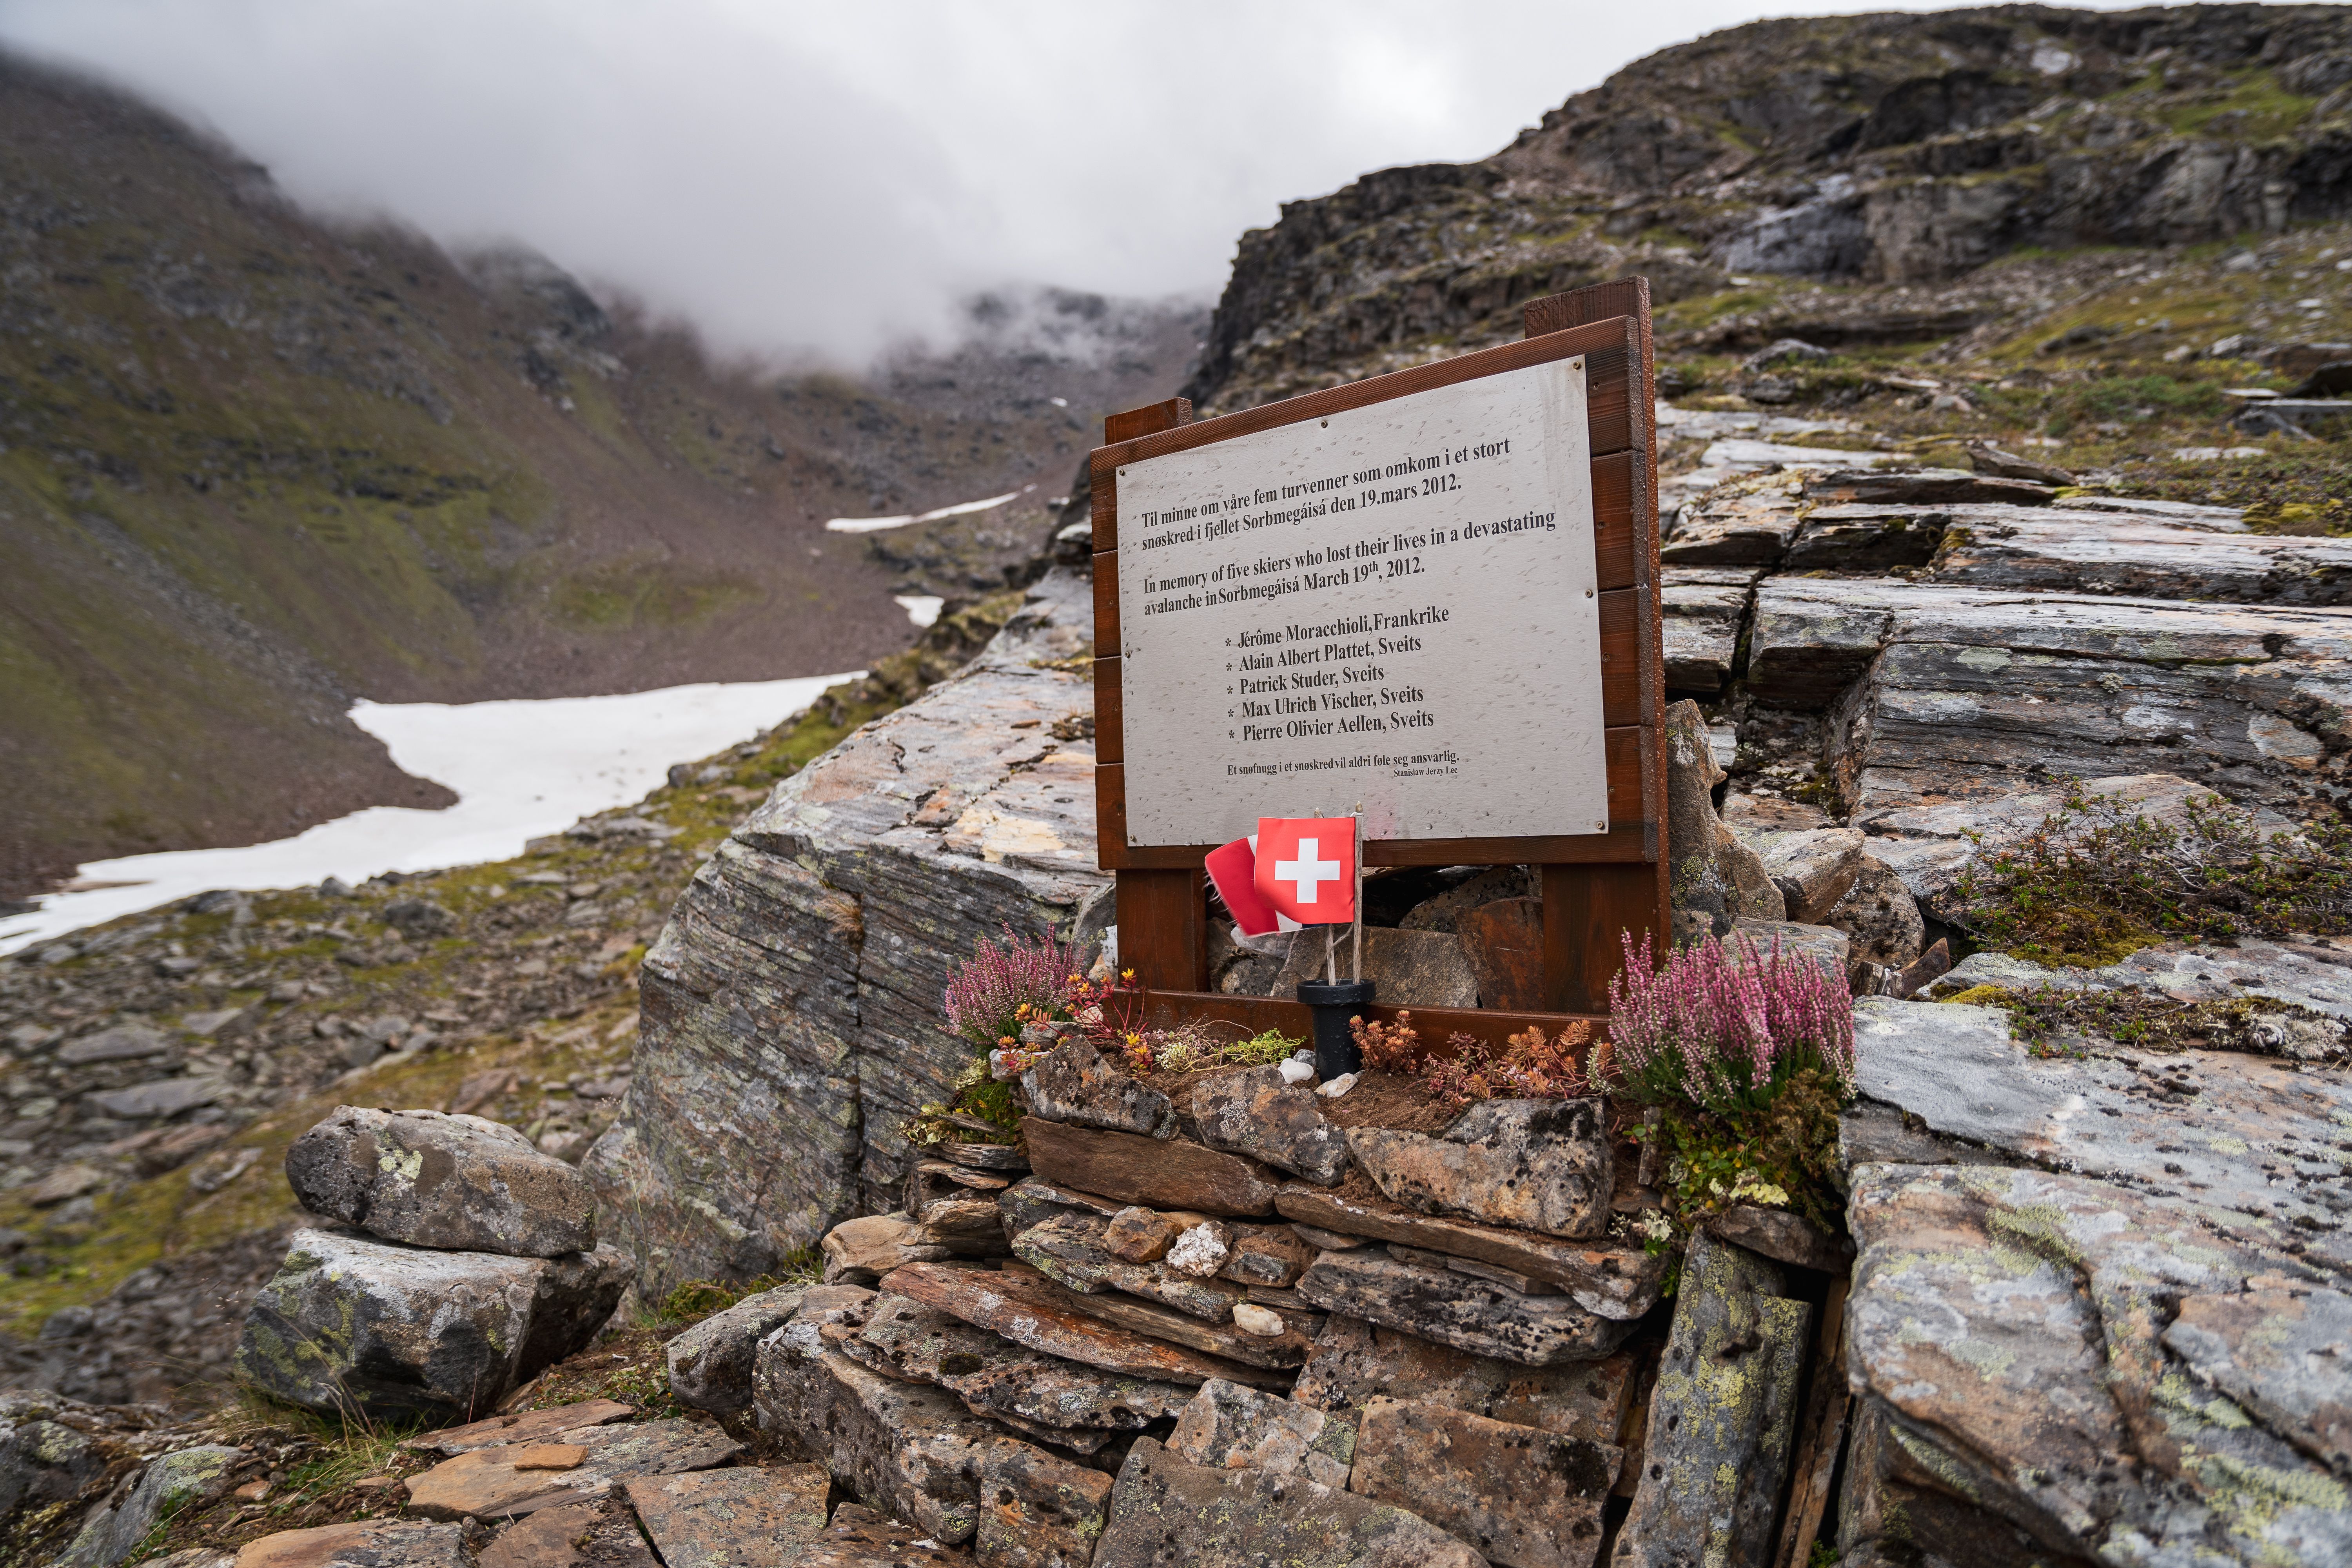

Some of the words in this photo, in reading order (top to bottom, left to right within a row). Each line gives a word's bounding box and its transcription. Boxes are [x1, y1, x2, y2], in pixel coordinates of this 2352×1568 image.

[1142, 511, 1158, 528] Til
[1161, 507, 1197, 524] minne
[1201, 502, 1220, 516] om
[1223, 494, 1250, 511] våre
[1254, 489, 1278, 505] fem
[1281, 474, 1348, 499] turvenner
[1353, 468, 1381, 485] som
[1386, 456, 1440, 478] omkom
[1445, 448, 1450, 466] i
[1455, 446, 1468, 463] et
[1473, 437, 1510, 460] stort
[1142, 526, 1194, 550] snøskred
[1197, 524, 1201, 539] i
[1205, 518, 1240, 542] fjellet
[1243, 498, 1327, 530] Sorbmegáisá
[1331, 496, 1356, 514] den
[1422, 473, 1461, 496] 2012.
[1143, 578, 1156, 594] In
[1160, 572, 1208, 591] memory
[1212, 565, 1225, 582] of
[1227, 563, 1249, 580] five
[1253, 557, 1291, 575] skiers
[1294, 550, 1322, 568] who
[1326, 544, 1351, 563] lost
[1355, 537, 1389, 558] their
[1393, 534, 1426, 552] lives
[1430, 528, 1445, 545] in
[1450, 529, 1459, 542] a
[1464, 511, 1555, 539] devastating
[1145, 593, 1202, 615] avalanche
[1205, 590, 1217, 606] in
[1219, 575, 1300, 604] Sorbmegáisá
[1303, 568, 1349, 591] March
[1387, 556, 1425, 578] 2012.
[1238, 629, 1282, 648] Jérôme
[1239, 653, 1274, 671] Alain
[1277, 647, 1321, 667] Albert
[1323, 641, 1374, 661] Plattet,
[1379, 635, 1421, 655] Sveits
[1240, 674, 1288, 695] Patrick
[1291, 670, 1339, 690] Studer,
[1343, 664, 1384, 684] Sveits
[1241, 701, 1271, 718] Max
[1274, 695, 1317, 715] Ulrich
[1320, 691, 1376, 710] Vischer,
[1381, 685, 1423, 705] Sveits
[1243, 724, 1283, 741] Pierre
[1287, 719, 1334, 737] Olivier
[1337, 715, 1387, 734] Aellen,
[1390, 710, 1434, 730] Sveits
[1227, 765, 1237, 775] Et
[1239, 763, 1277, 776] snøfnugg
[1279, 761, 1282, 772] i
[1284, 762, 1292, 772] et
[1294, 758, 1334, 771] snøskred
[1349, 755, 1371, 768] aldri
[1373, 754, 1390, 766] føle
[1393, 756, 1408, 767] seg
[1411, 750, 1459, 764] ansvarlig.
[1394, 768, 1424, 777] Stanislaw
[1426, 767, 1443, 775] Jerzy
